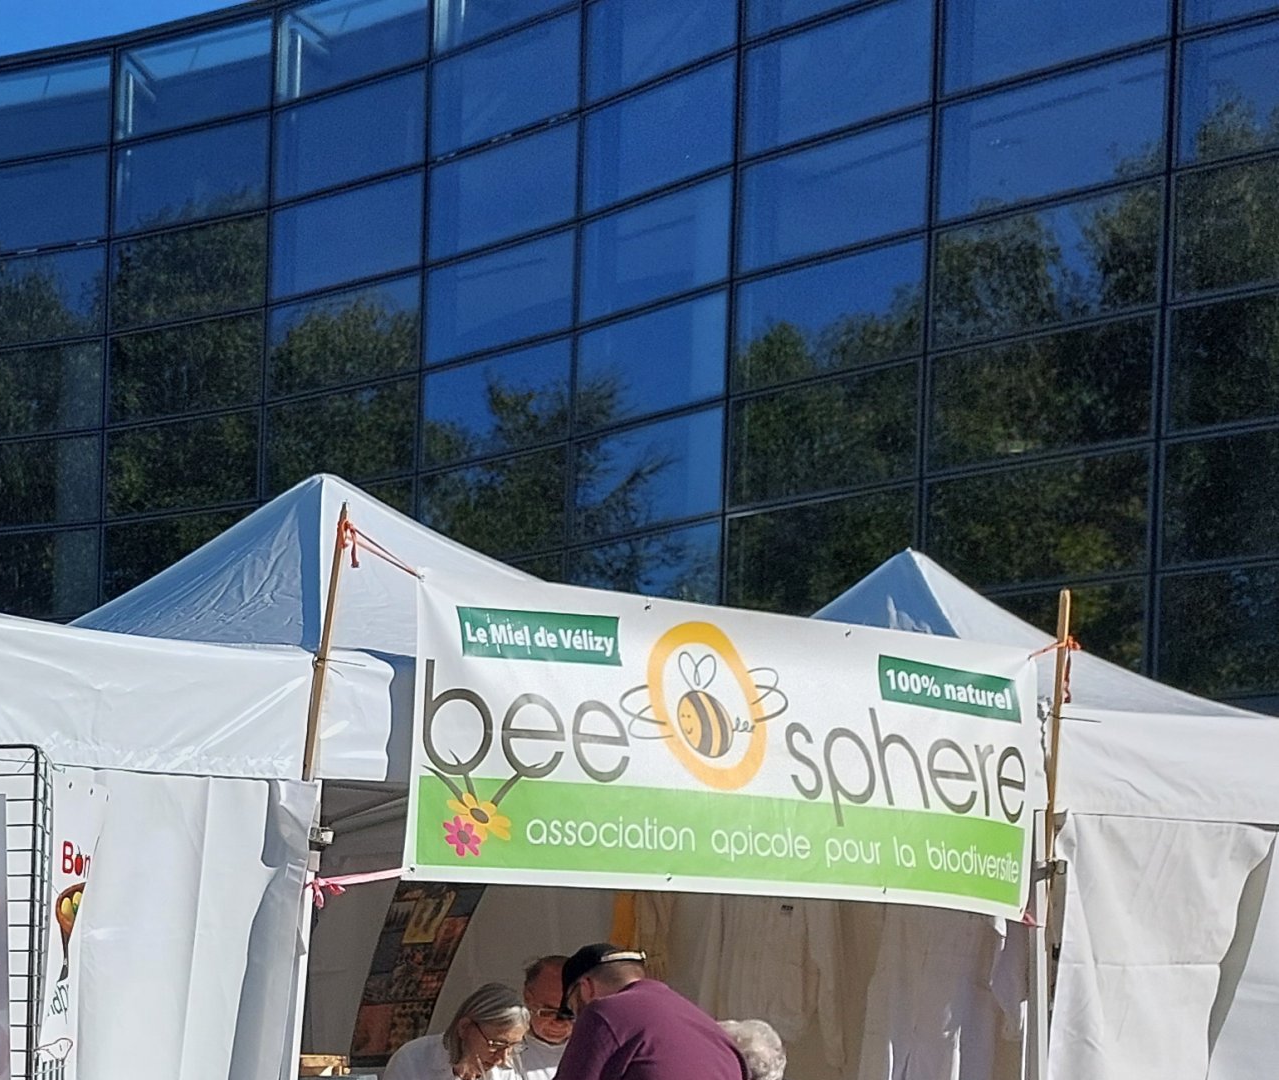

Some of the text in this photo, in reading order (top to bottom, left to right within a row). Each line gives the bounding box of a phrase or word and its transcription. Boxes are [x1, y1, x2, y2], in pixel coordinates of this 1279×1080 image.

[465, 622, 614, 657] Le Miel de Vélizy
[886, 669, 1012, 710] 100% naturel
[526, 818, 695, 851] association
[711, 827, 811, 861] apicole
[826, 835, 880, 867] pour
[894, 836, 916, 868] la
